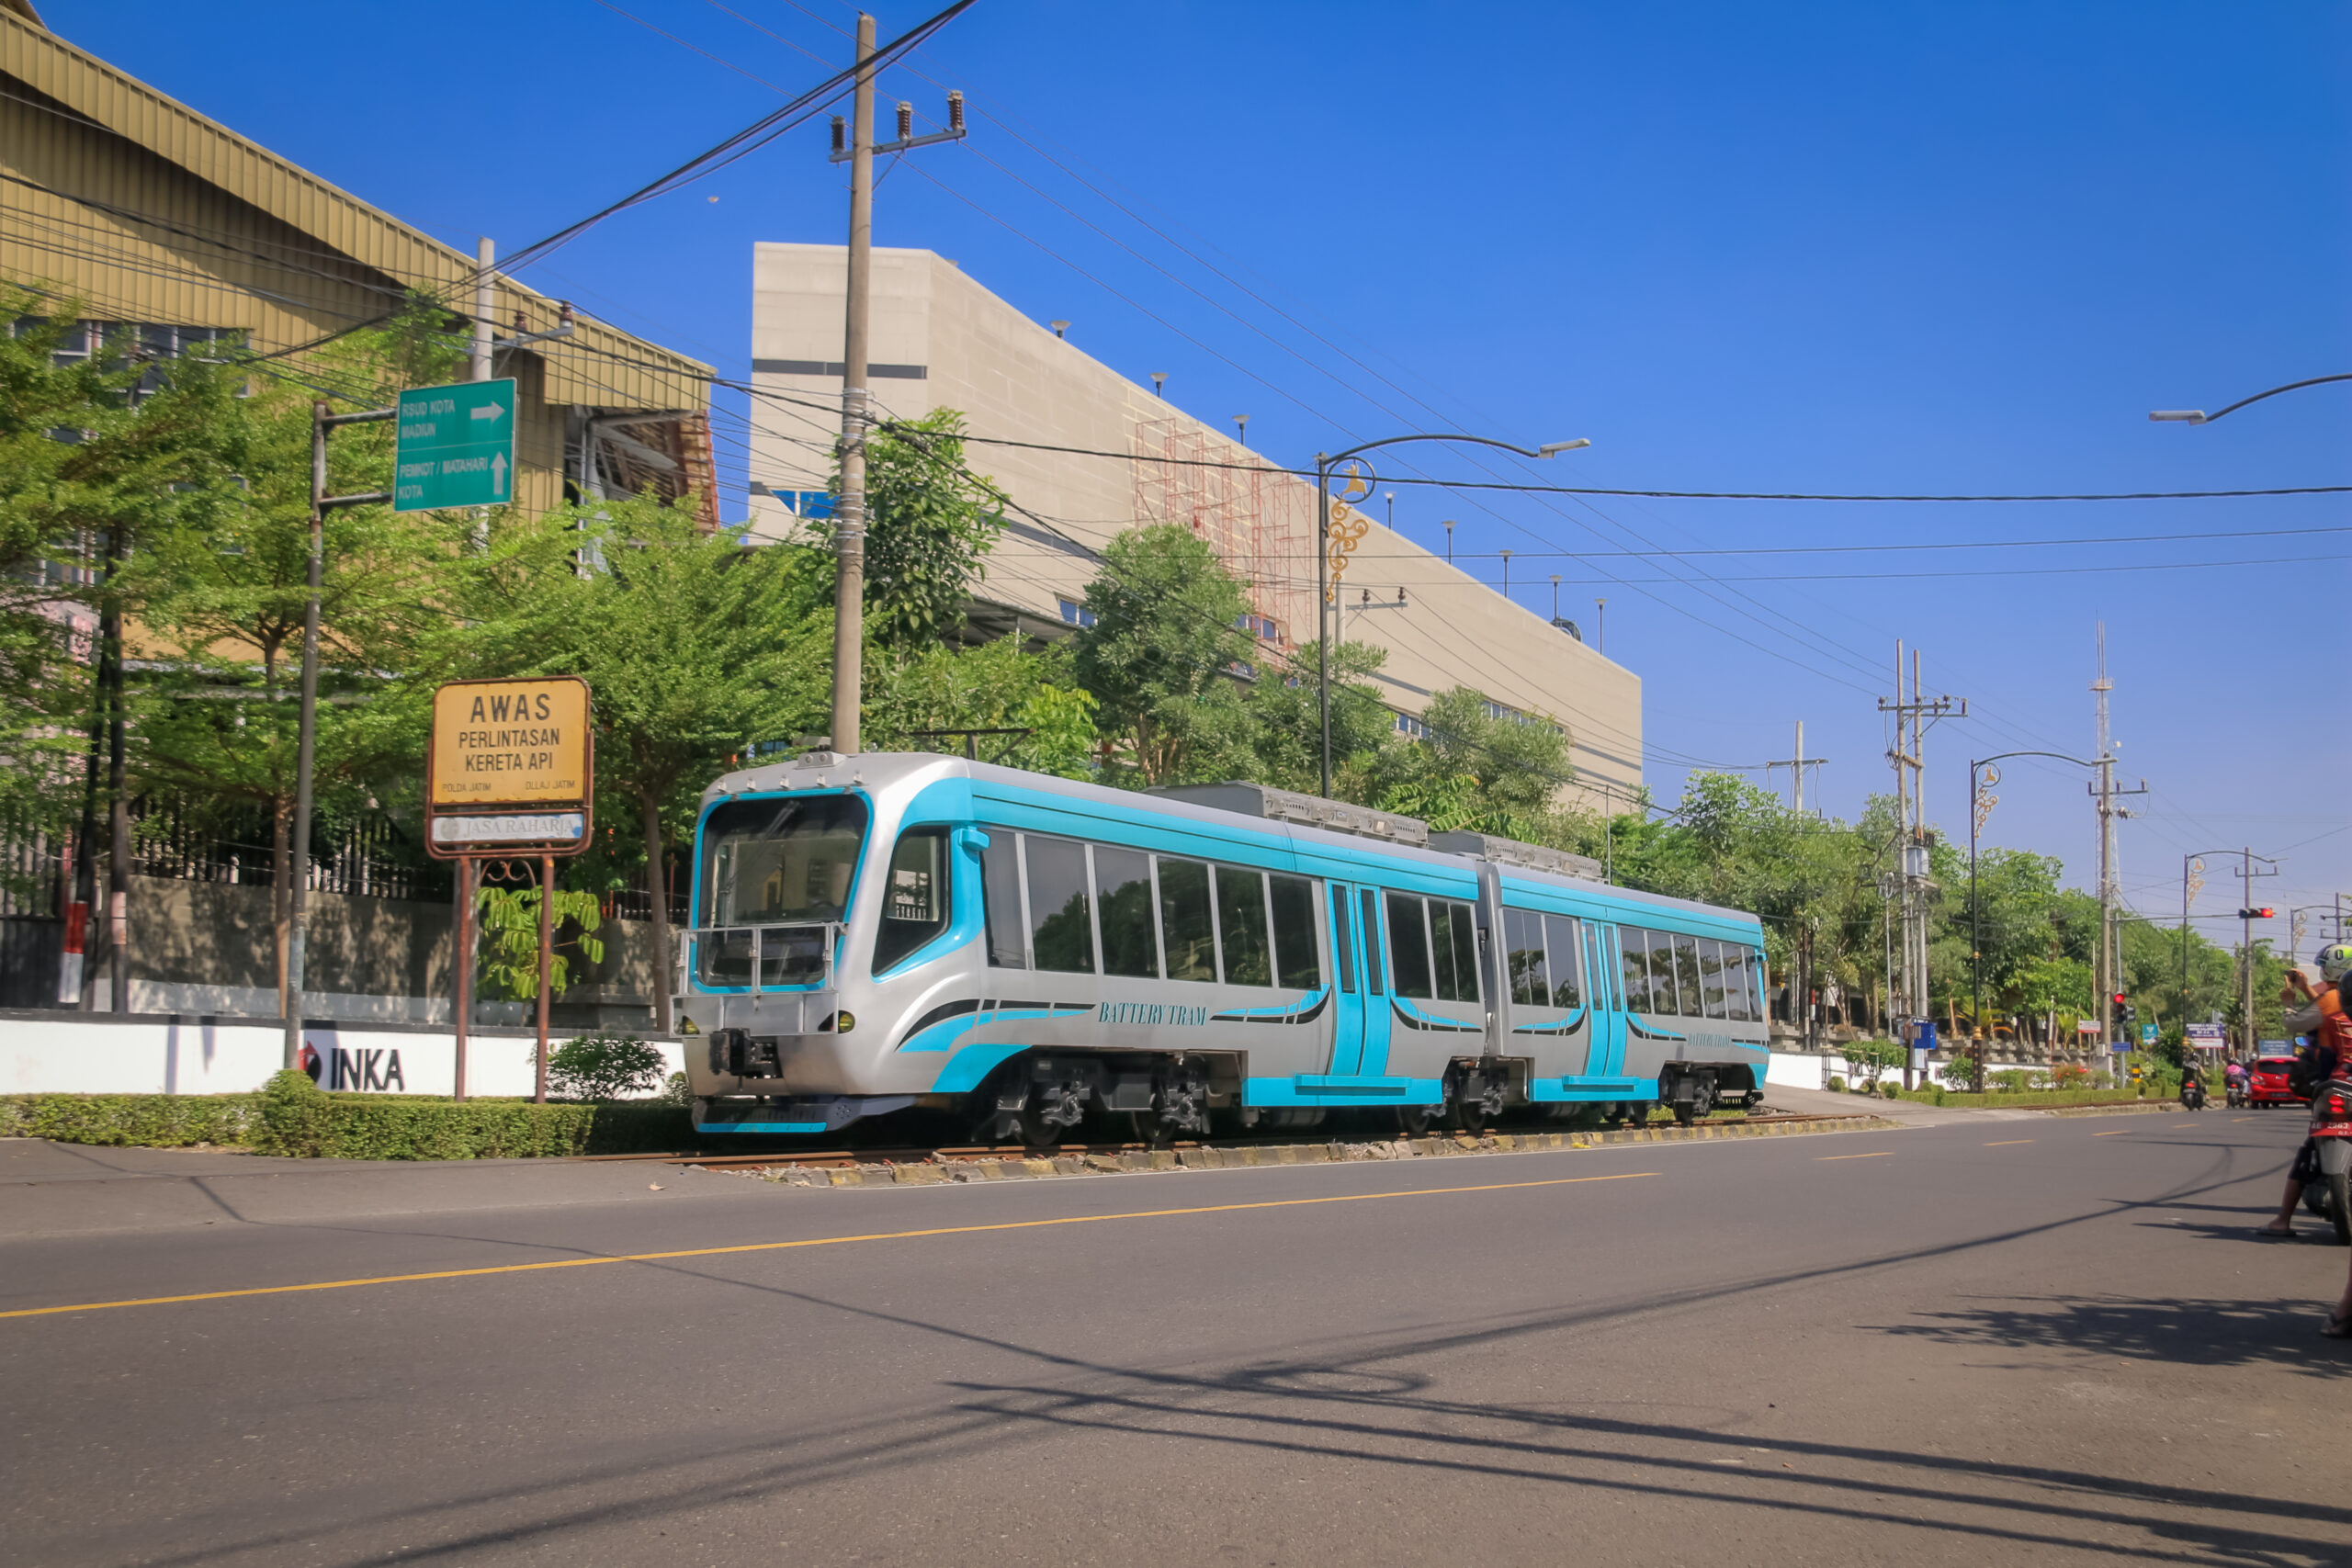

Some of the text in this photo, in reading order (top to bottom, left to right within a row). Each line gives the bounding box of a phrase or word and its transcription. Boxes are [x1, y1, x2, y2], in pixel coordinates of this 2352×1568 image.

[401, 399, 456, 417] RSUD KOTA
[401, 423, 436, 439] MADIUN
[399, 462, 435, 478] PEMKOT
[442, 457, 489, 474] MATAHARI
[398, 485, 424, 500] KOTA
[470, 694, 550, 724] AWAS
[458, 728, 560, 749] PERLINTASAN
[466, 752, 553, 772] KERETA API
[442, 783, 492, 793] POLDA JATIM
[552, 780, 575, 789] JATIM
[463, 818, 574, 838] JASA RAHARJA
[1099, 1002, 1207, 1026] BATTERY TRAM
[331, 1048, 405, 1091] INKA
